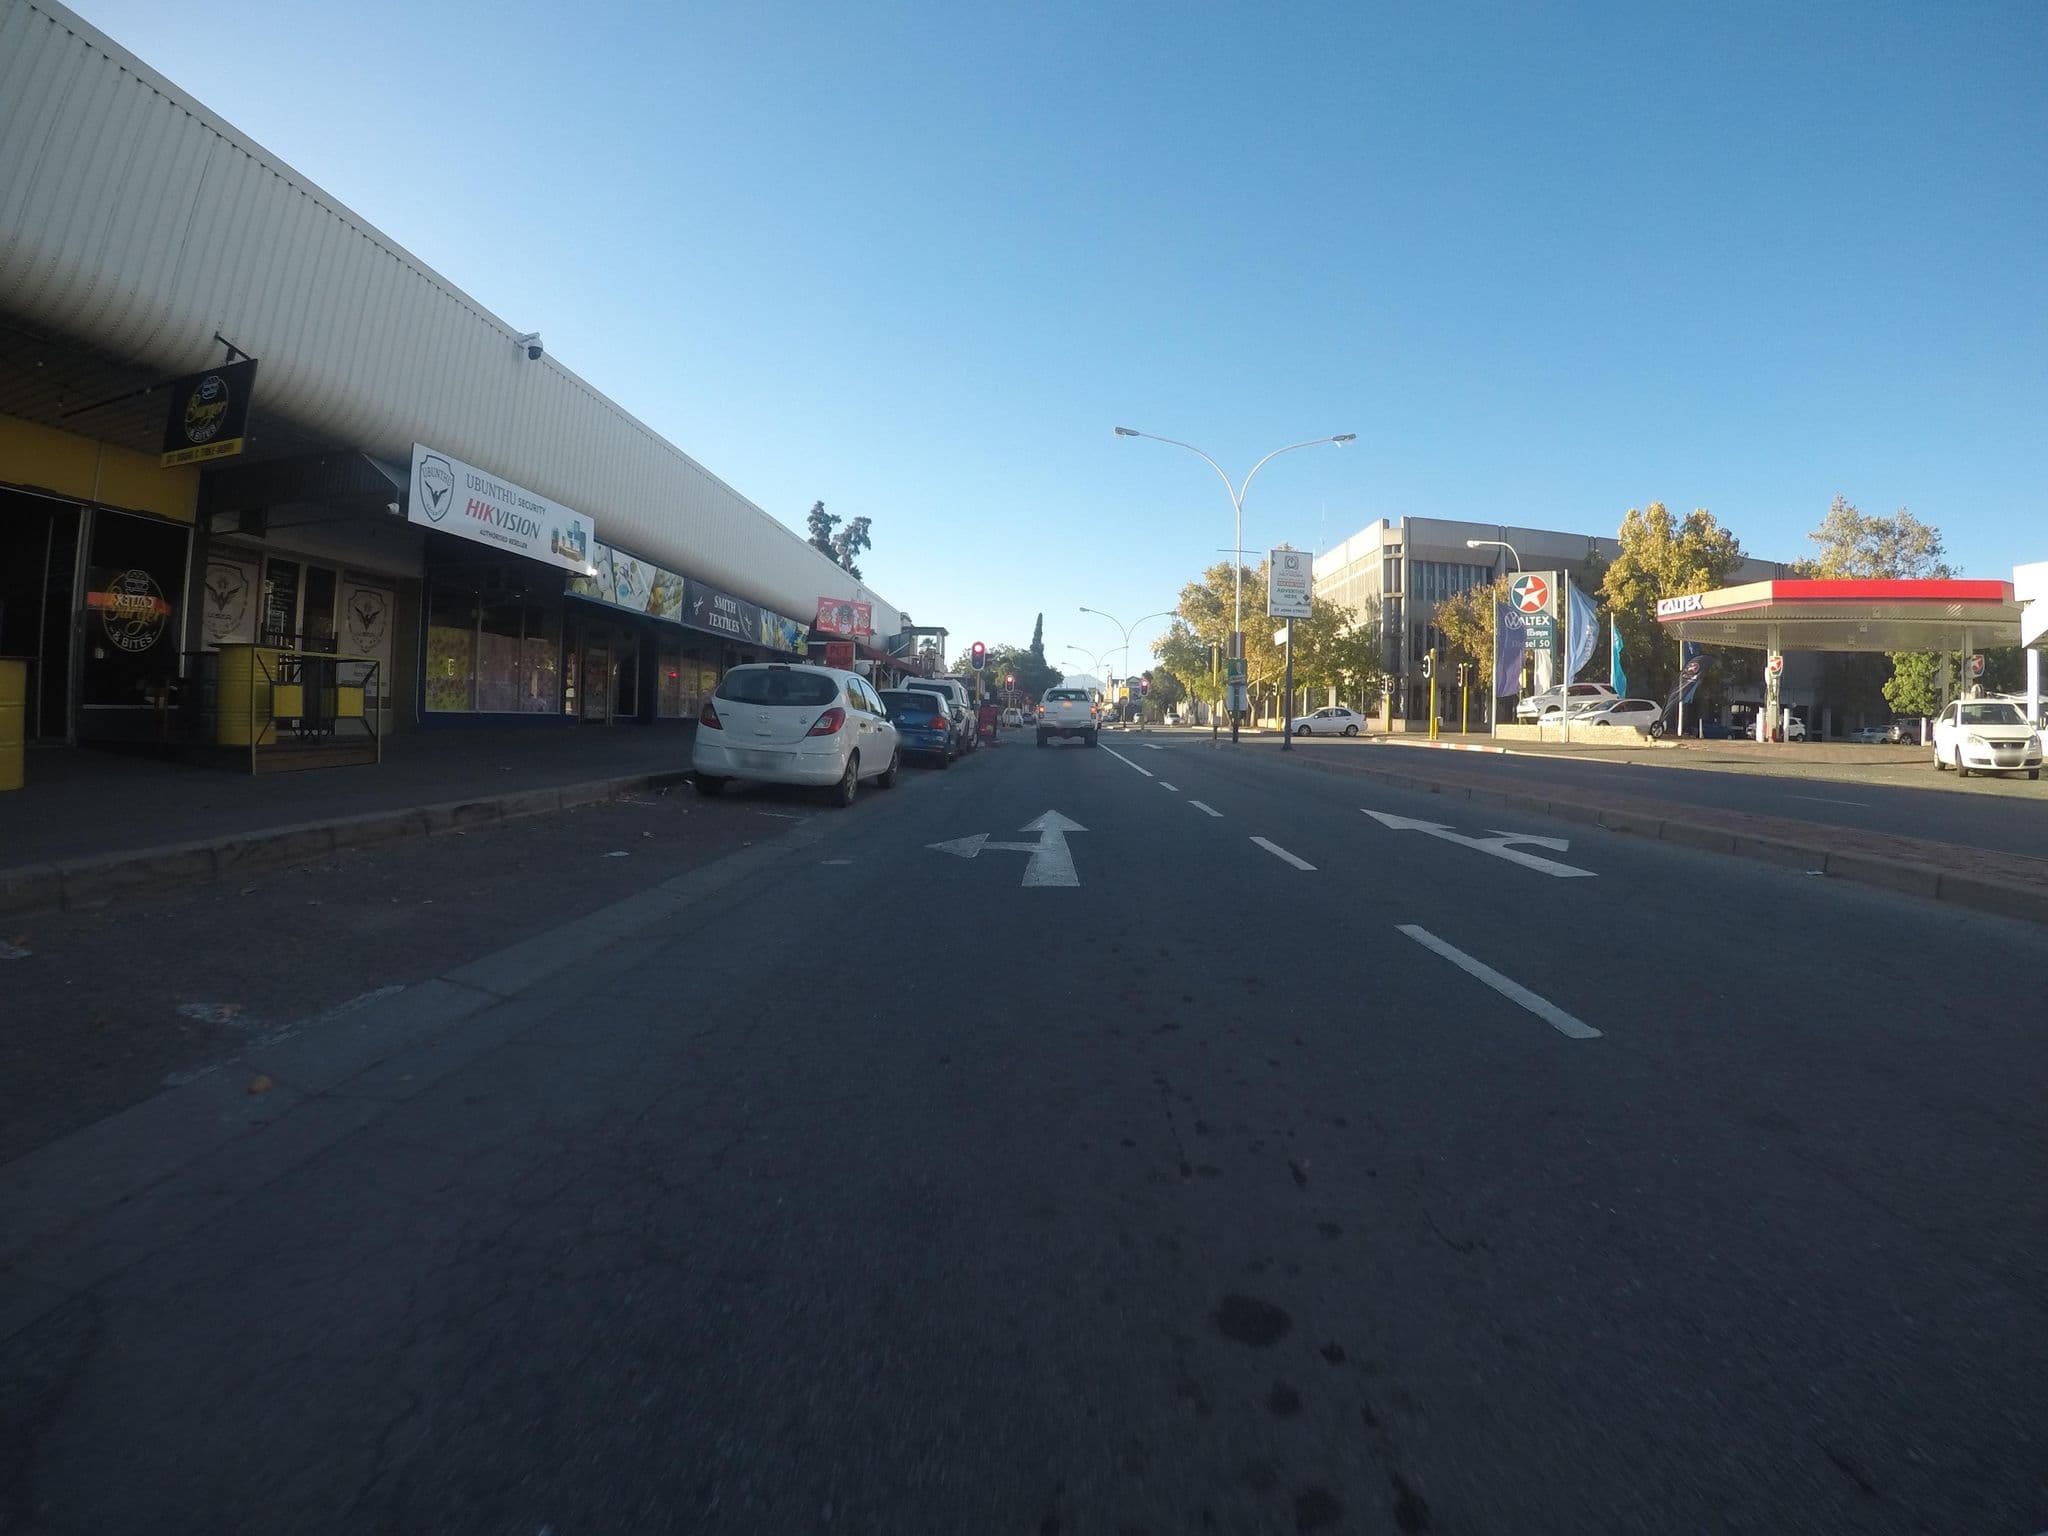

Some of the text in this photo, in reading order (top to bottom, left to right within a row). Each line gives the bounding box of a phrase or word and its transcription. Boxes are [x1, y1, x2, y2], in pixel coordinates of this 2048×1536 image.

[466, 473, 547, 516] UBUNTHU SECURITY
[464, 497, 541, 540] HIKVISION
[713, 595, 737, 614] SMITH
[1660, 595, 1704, 614] CALTEX
[708, 612, 740, 633] TEXTILES
[1519, 615, 1550, 626] ALTEX
[121, 634, 153, 650] BITES
[1538, 639, 1551, 649] 50
